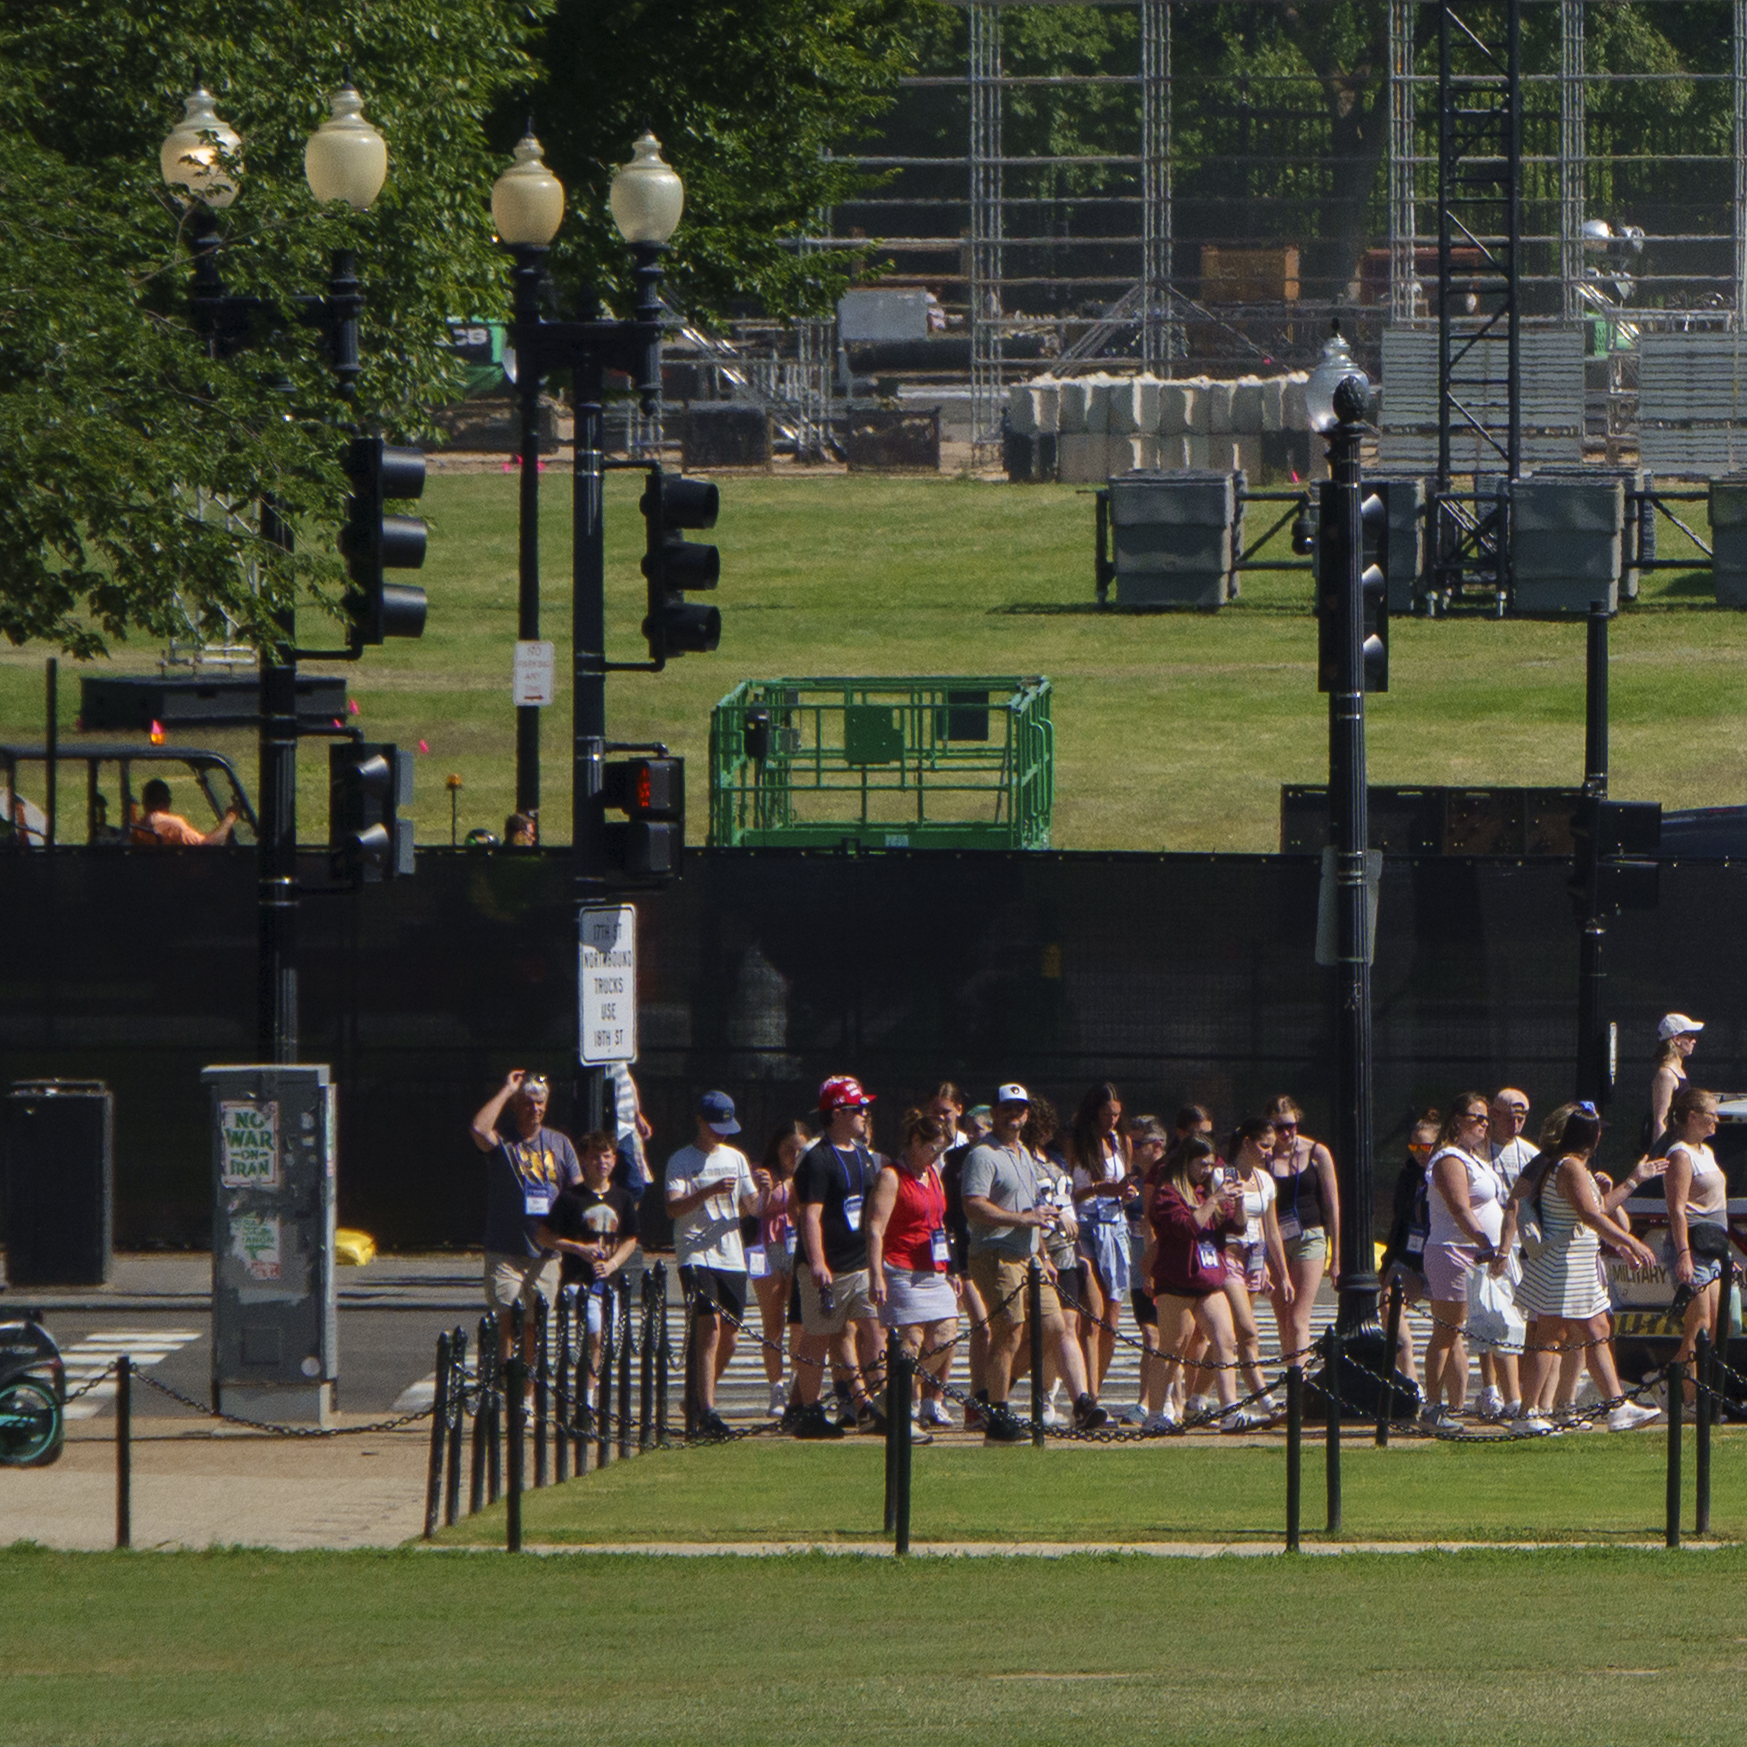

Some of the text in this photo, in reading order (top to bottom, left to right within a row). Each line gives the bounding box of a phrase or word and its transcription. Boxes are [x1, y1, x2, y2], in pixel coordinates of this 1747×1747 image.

[434, 327, 487, 346] CB
[593, 924, 622, 940] 17TH ST
[584, 951, 632, 968] NORTHBOUND
[594, 977, 624, 995] TRUCKS
[601, 1003, 617, 1020] USE
[594, 1029, 624, 1047] 18TH ST
[234, 1112, 265, 1129] NO
[223, 1129, 275, 1150] WAR
[241, 1150, 259, 1160] ON
[230, 1160, 270, 1177] IRAN
[1611, 1264, 1666, 1284] MILITARY
